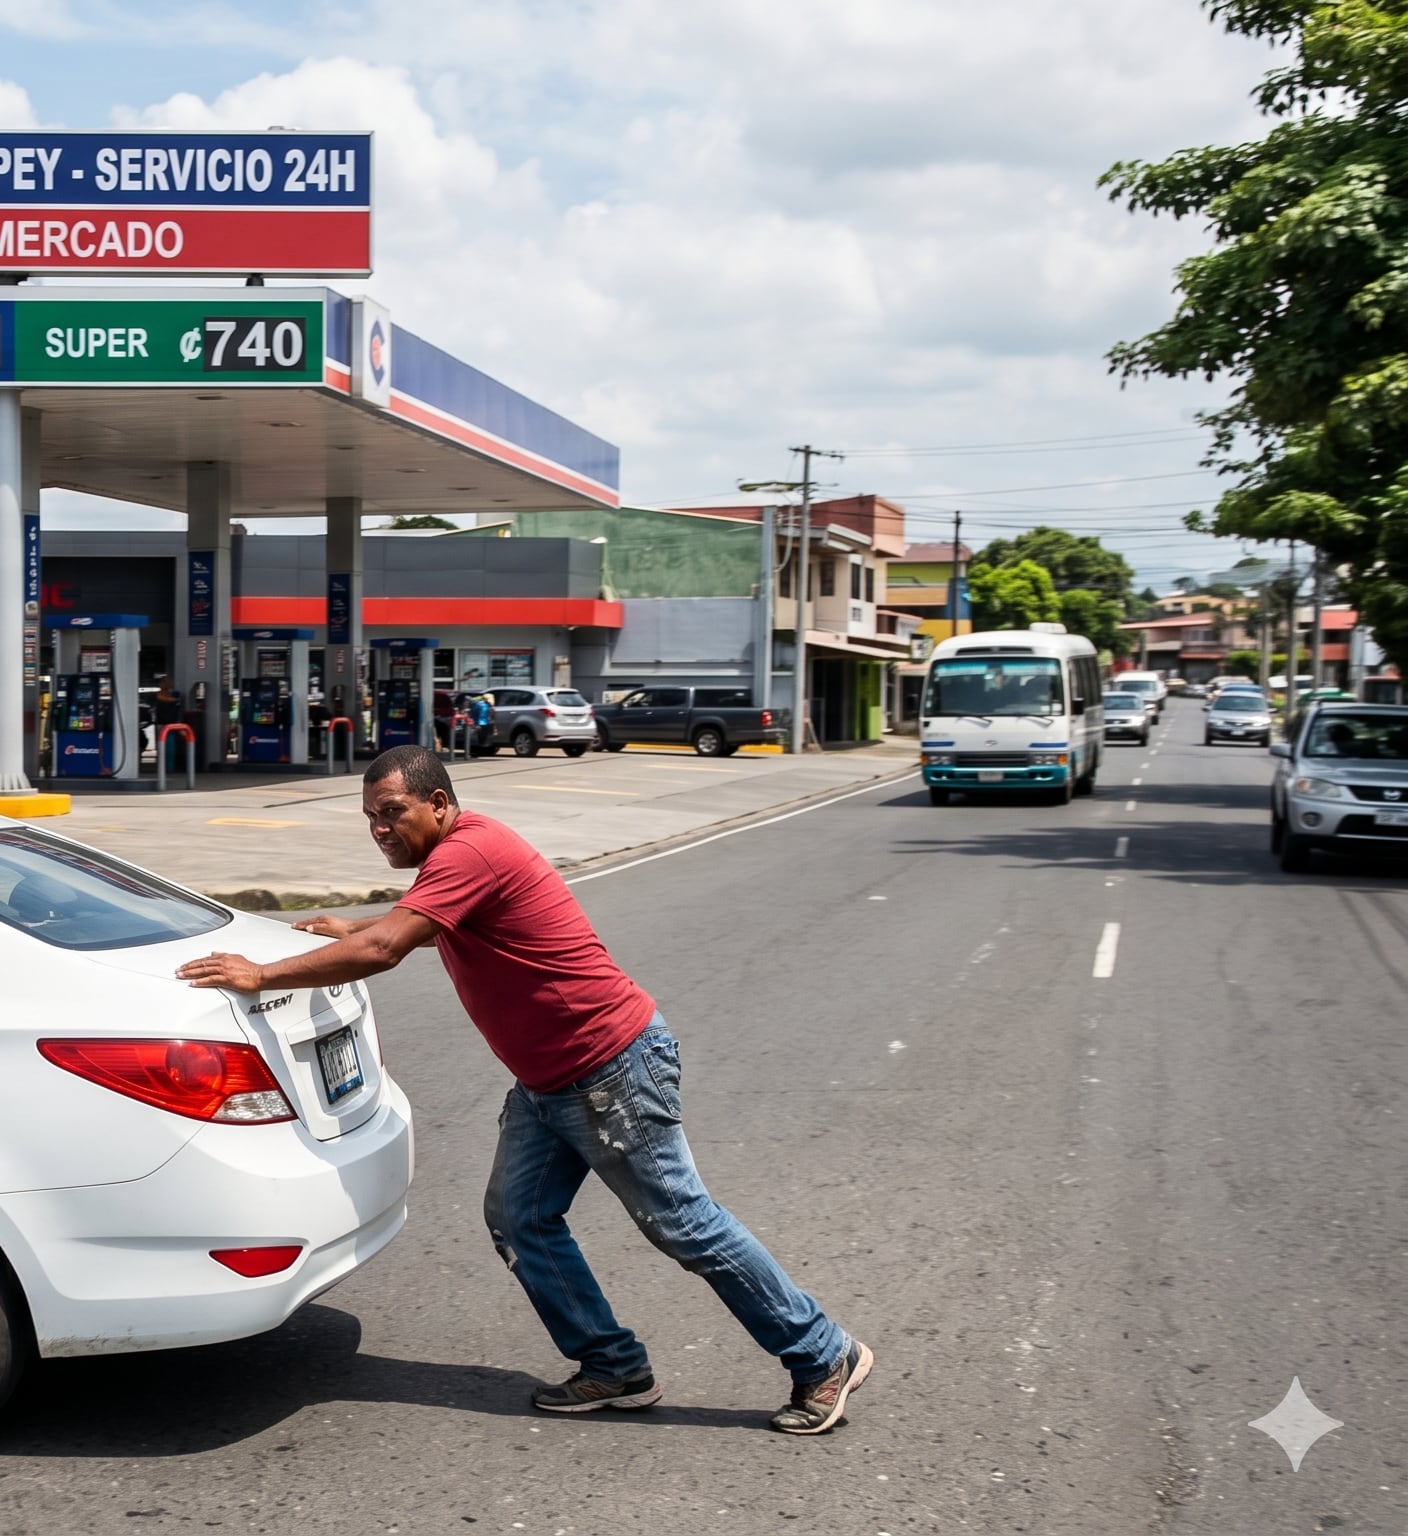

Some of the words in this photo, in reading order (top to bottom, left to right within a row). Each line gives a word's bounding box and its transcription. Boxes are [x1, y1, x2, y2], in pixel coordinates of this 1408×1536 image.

[95, 147, 273, 192] SERVICIO
[283, 149, 355, 192] 24H
[45, 327, 149, 358] SUPER
